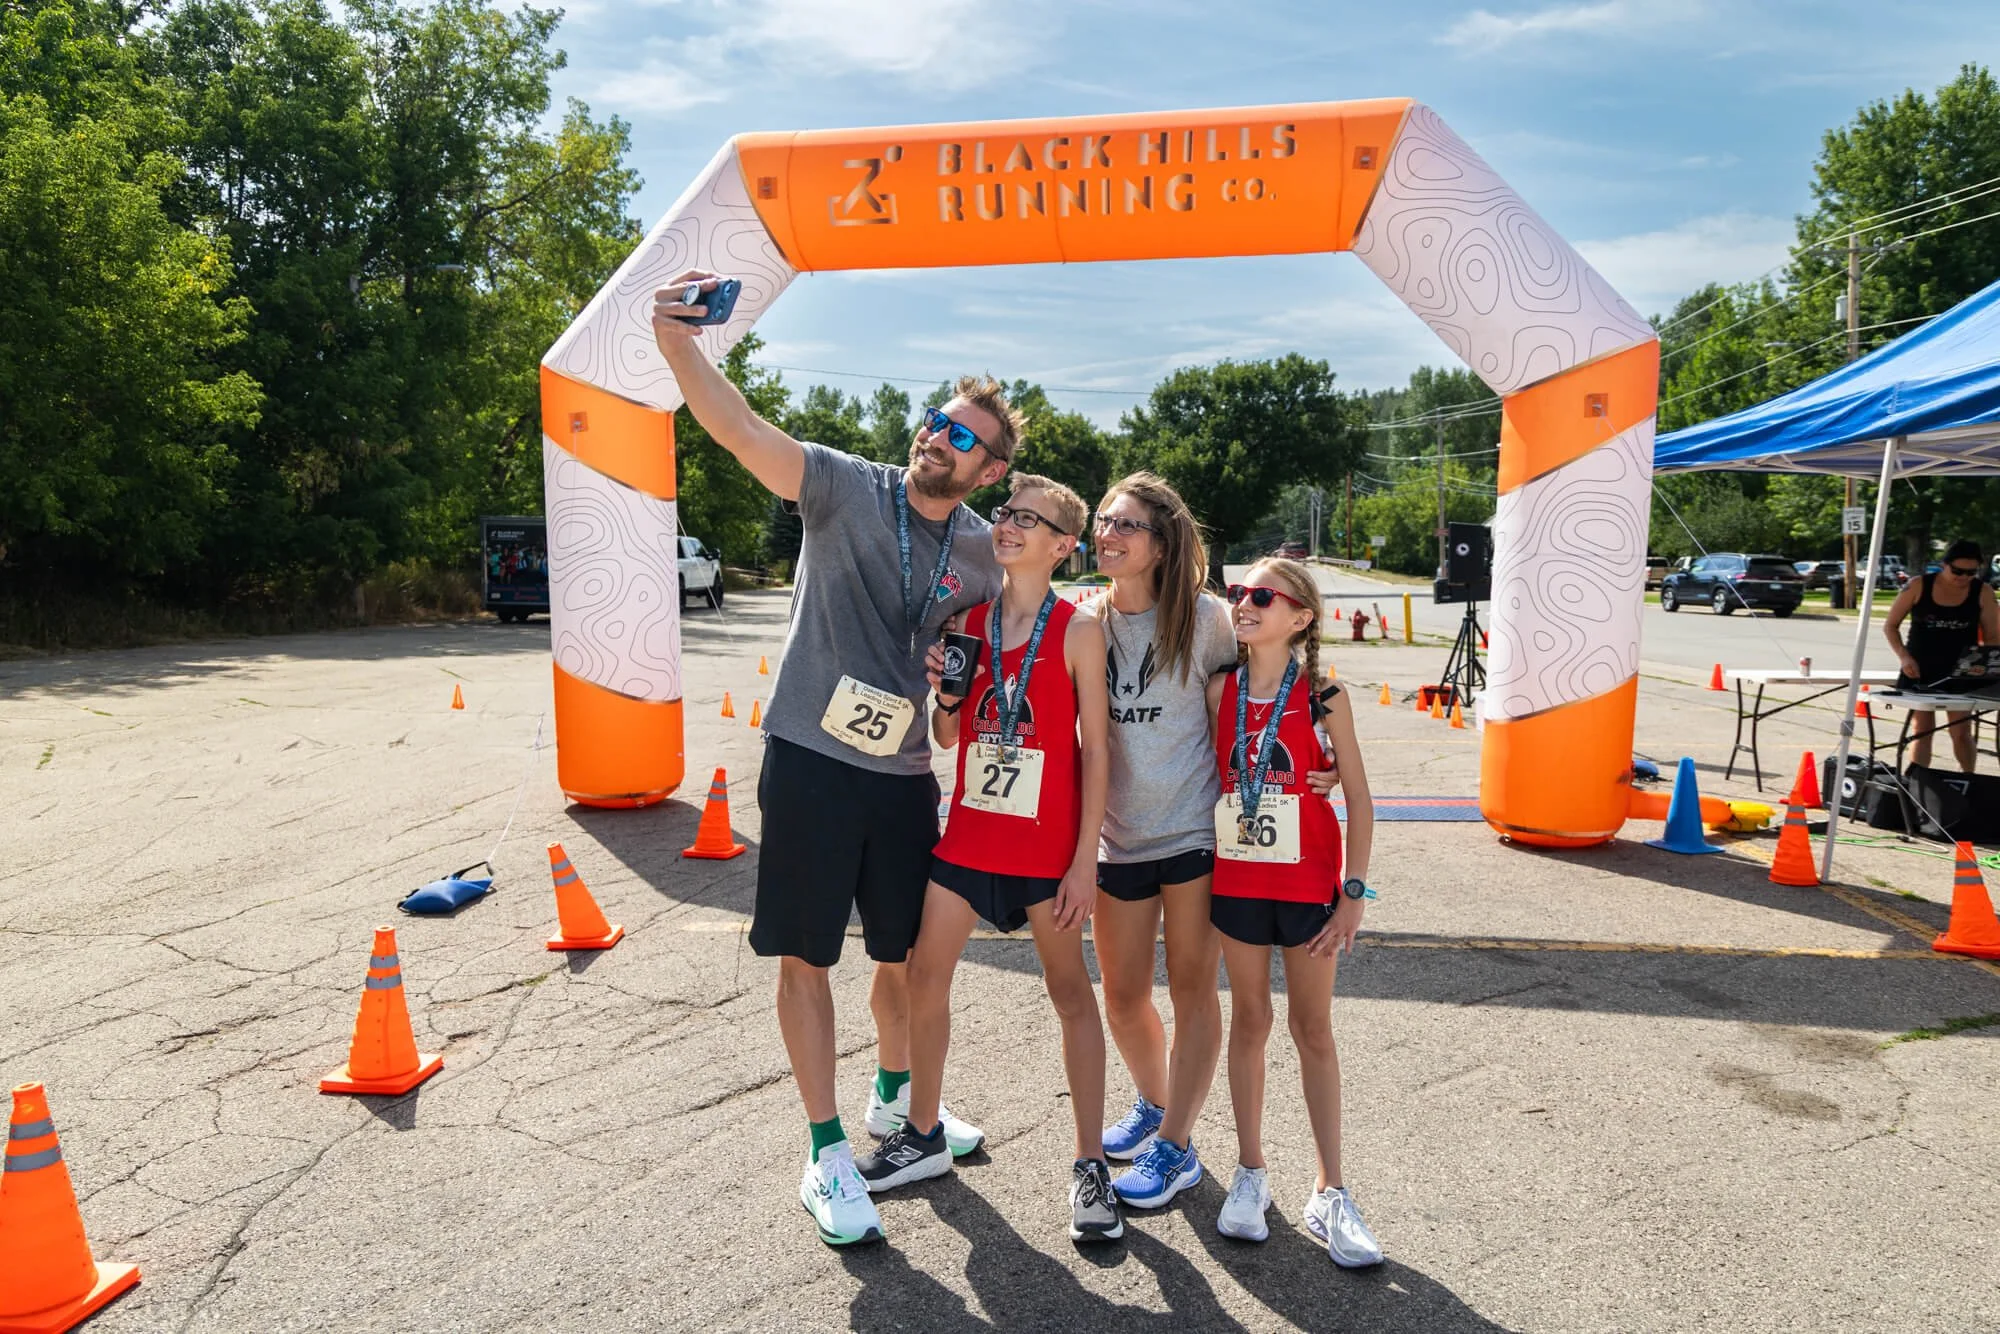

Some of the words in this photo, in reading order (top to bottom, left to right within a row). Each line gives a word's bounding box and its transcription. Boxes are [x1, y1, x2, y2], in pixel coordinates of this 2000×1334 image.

[937, 135, 1111, 175] BLACK
[1139, 124, 1297, 165] HILLS
[938, 173, 1196, 222] RUNNING
[1221, 178, 1277, 202] CO.
[1847, 520, 1862, 531] 15
[846, 703, 893, 740] 25
[1108, 706, 1162, 723] SATF
[974, 717, 1035, 735] COLODO
[978, 733, 1023, 745] COYS
[982, 764, 1020, 798] 27
[1233, 783, 1283, 794] CTES
